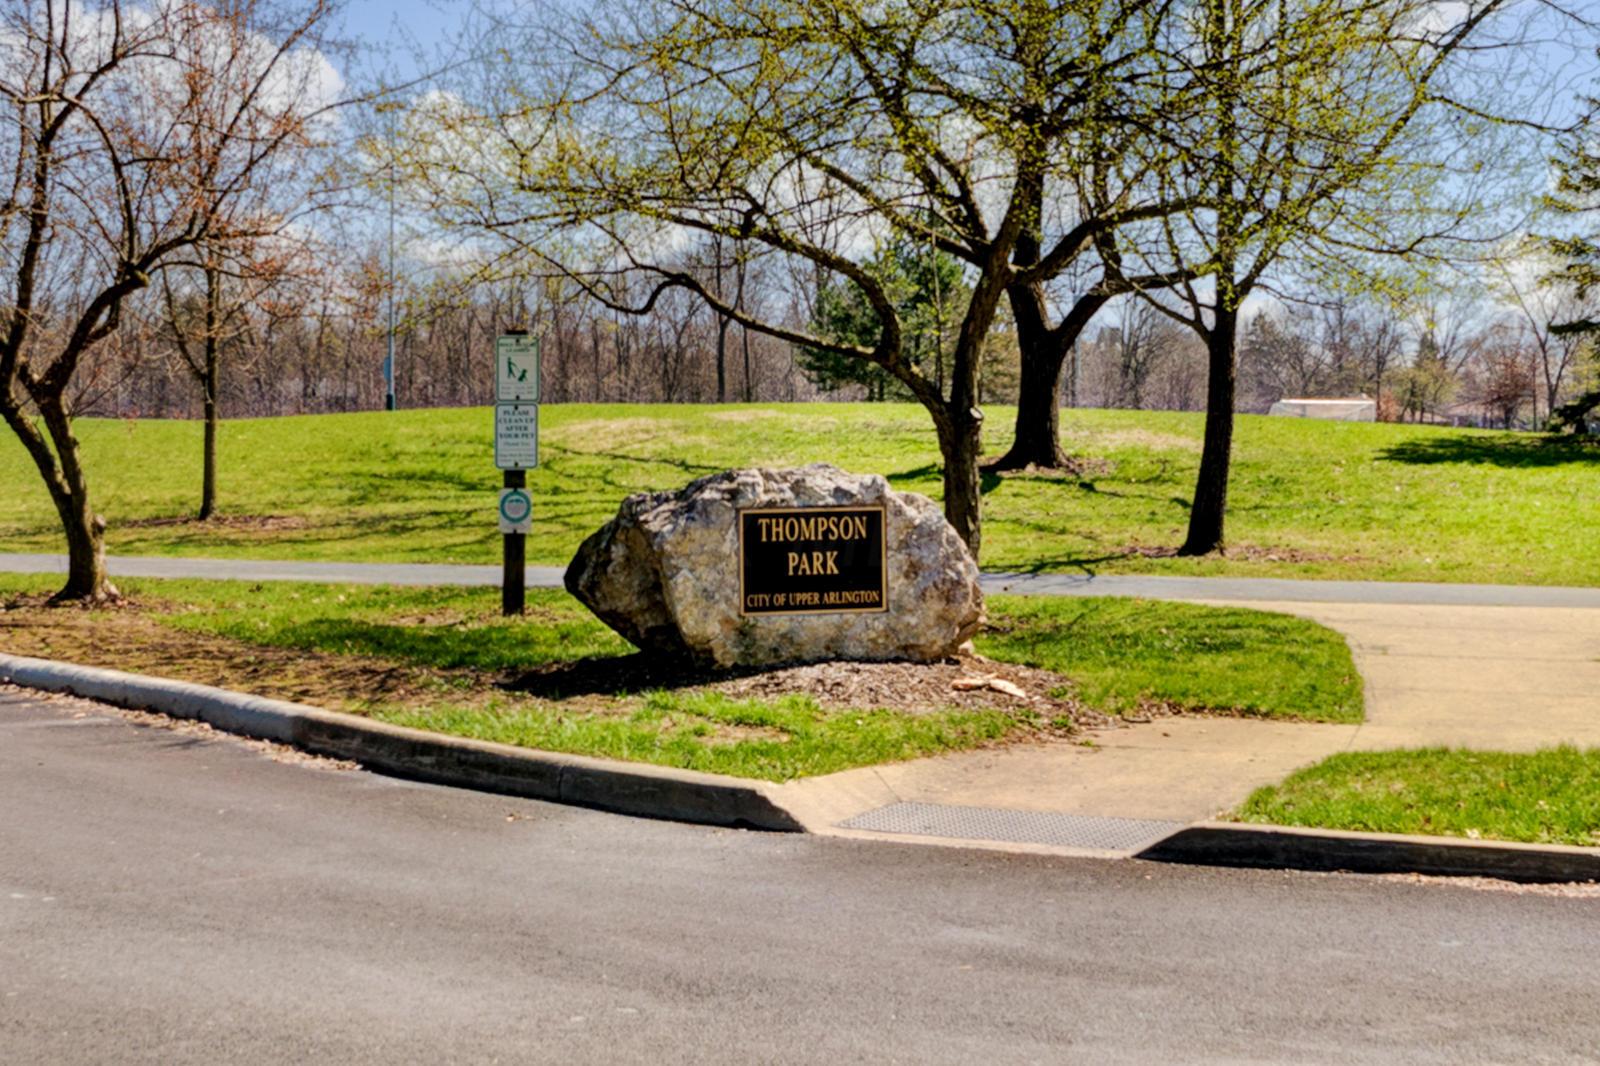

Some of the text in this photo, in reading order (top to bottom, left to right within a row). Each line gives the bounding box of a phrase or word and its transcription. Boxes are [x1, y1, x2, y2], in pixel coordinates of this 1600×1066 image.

[758, 516, 867, 542] THOMPSON
[787, 551, 839, 576] PARK
[747, 590, 880, 607] CITY OF UPPER ARLINGTON
